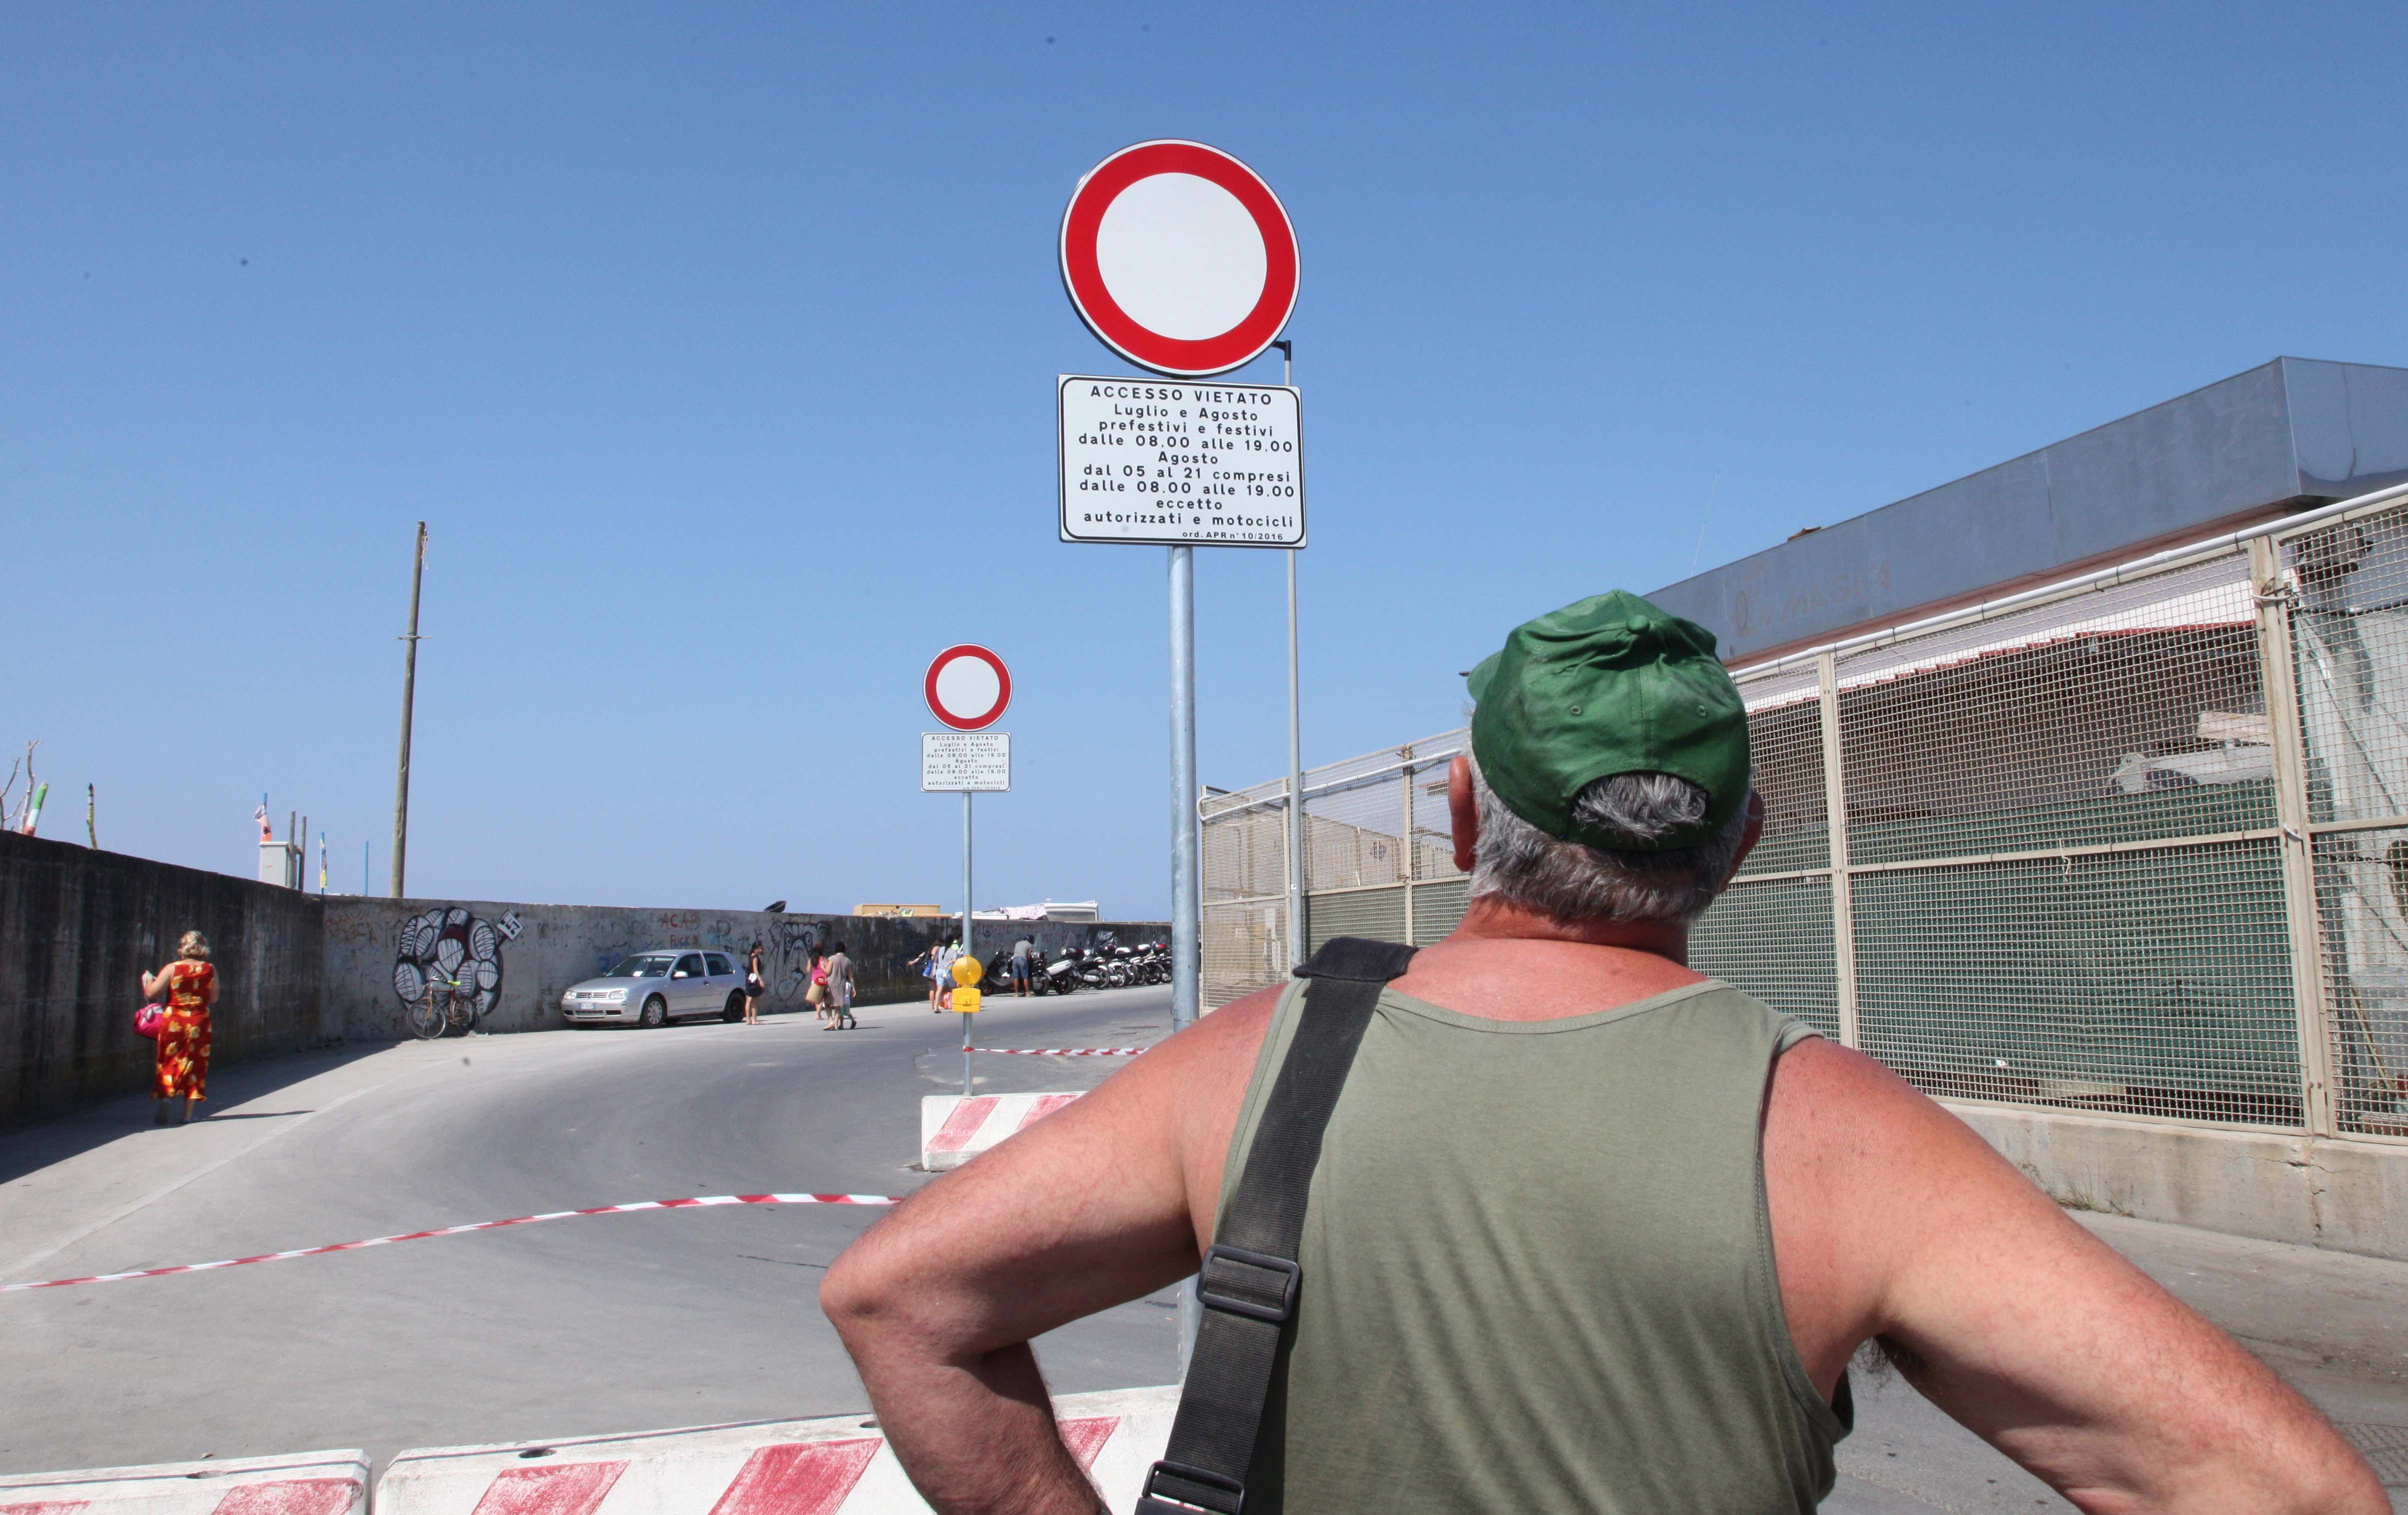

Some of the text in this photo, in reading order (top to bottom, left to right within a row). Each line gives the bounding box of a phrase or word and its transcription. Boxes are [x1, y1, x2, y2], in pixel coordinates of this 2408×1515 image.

[1091, 384, 1273, 405] ACCESSO VIETATO
[1115, 404, 1168, 418] Luglio
[1199, 408, 1257, 421] Agosto
[1100, 419, 1186, 433] prefestivi
[1217, 423, 1272, 436] festivi
[1079, 433, 1292, 452] dalle 08.00 alle 19.00
[1159, 451, 1218, 465] Agosto
[1084, 464, 1289, 483] dal 05 al 21 compresi
[1080, 479, 1294, 497] dalle 08.00 alle 19.00
[1157, 498, 1222, 510] eccetto
[1084, 511, 1181, 524] autorizzati
[1213, 515, 1292, 527] motocicli
